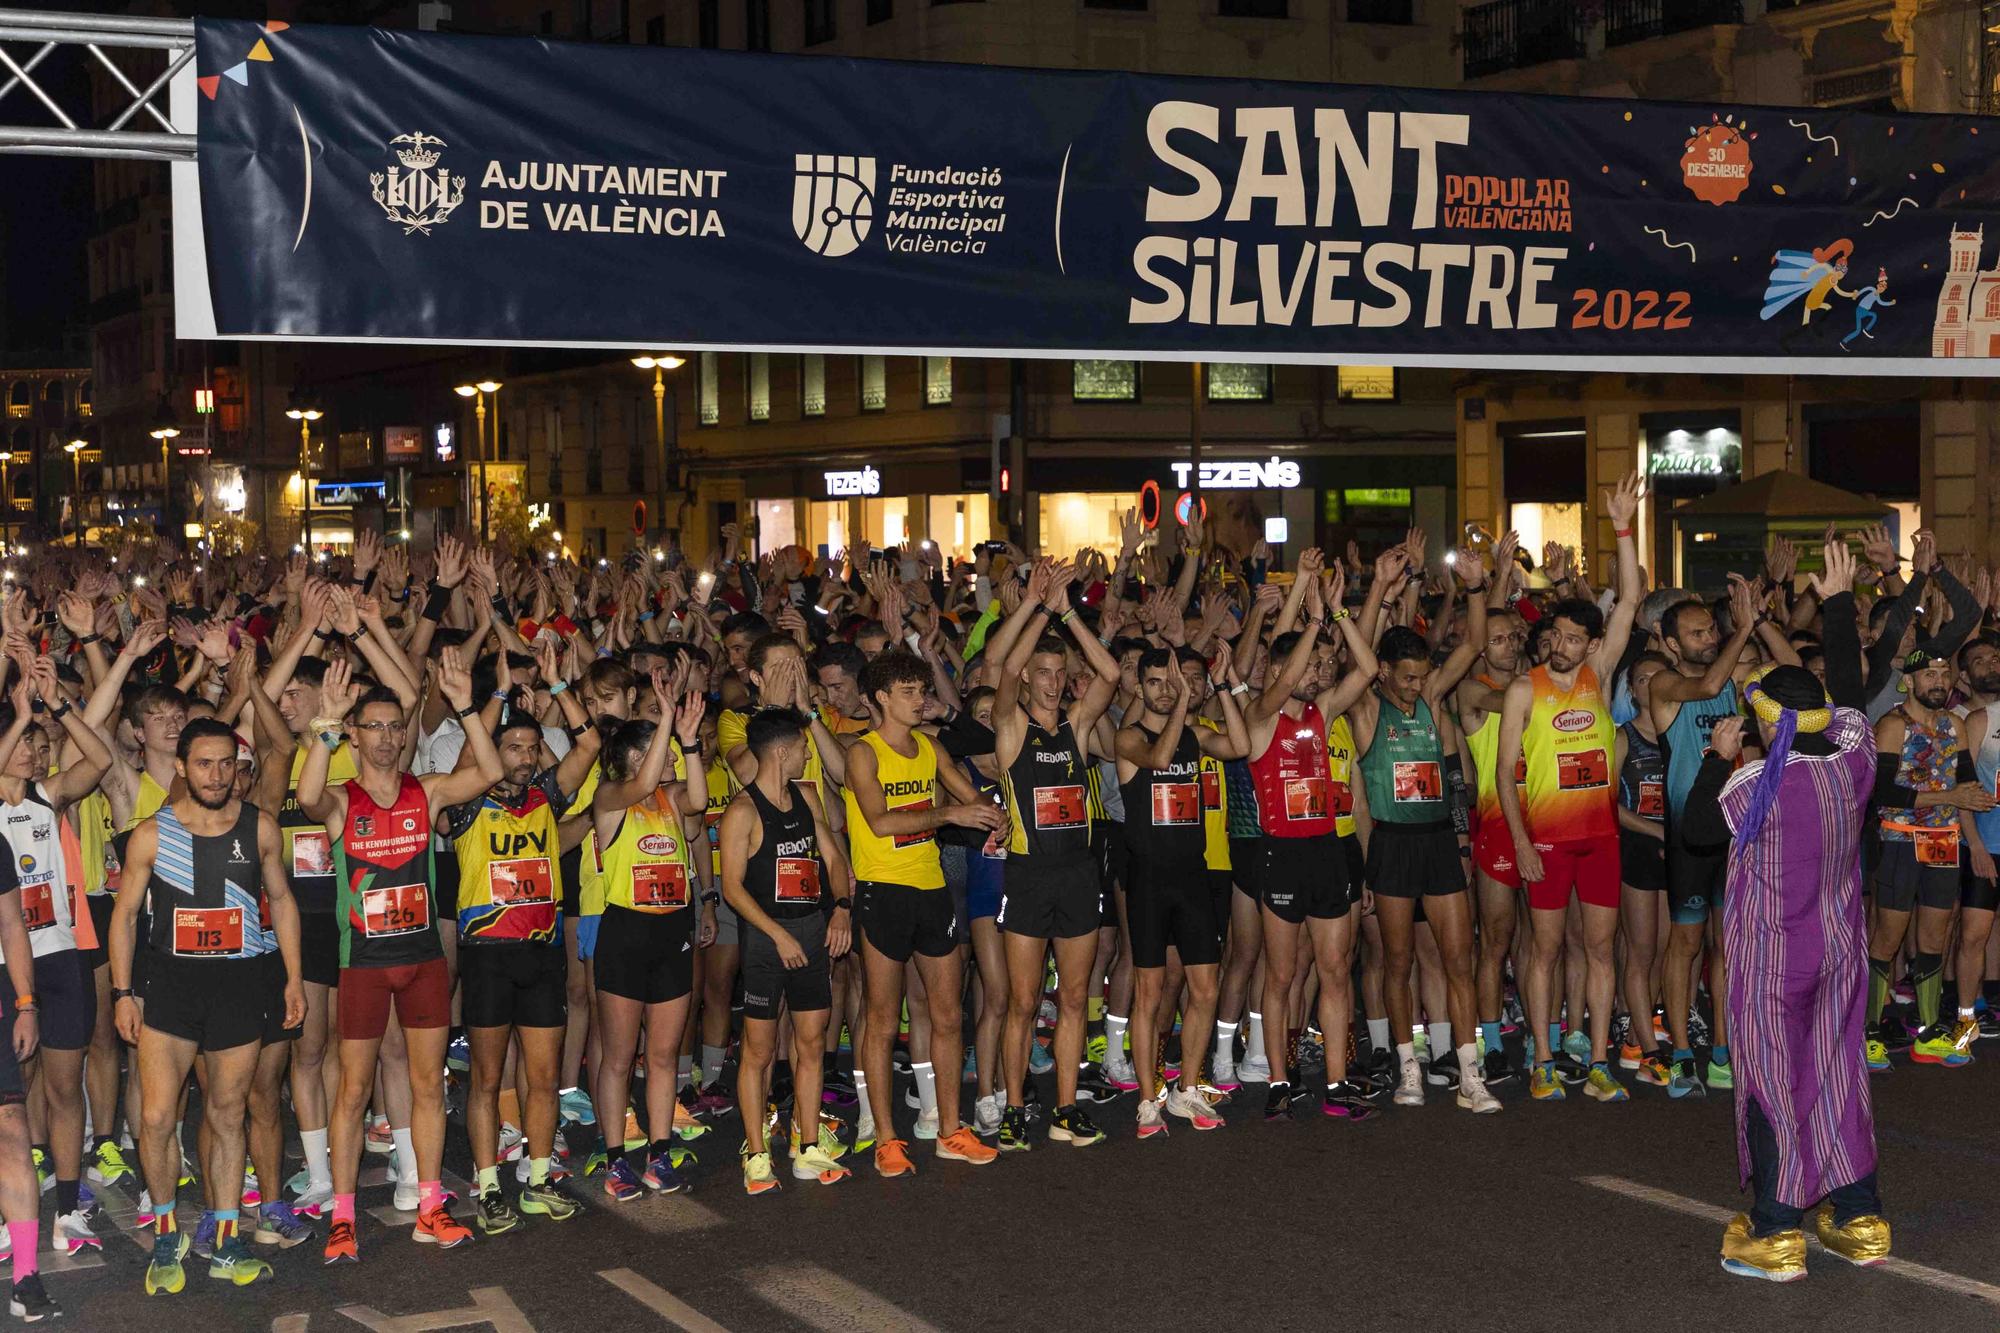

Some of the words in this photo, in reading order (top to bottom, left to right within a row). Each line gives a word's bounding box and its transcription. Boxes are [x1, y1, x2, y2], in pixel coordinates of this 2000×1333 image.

[1708, 147, 1726, 162] 30
[1145, 100, 1470, 230] SANT
[1687, 162, 1746, 178] DESEMBRE
[480, 160, 728, 198] AJUNTAMENT
[890, 164, 1002, 187] Fundació
[888, 187, 1005, 212] Esportiva
[1445, 175, 1571, 208] POPULAR
[480, 200, 529, 230] DE
[543, 198, 726, 238] VALÈNCIA
[886, 210, 1006, 236] Municipal
[885, 232, 987, 254] València
[1572, 289, 1692, 330] 2022
[1558, 714, 1592, 728] Serrano
[1576, 768, 1592, 781] 12
[1417, 780, 1426, 793] 4
[1060, 805, 1069, 819] 5
[1176, 802, 1184, 816] 7
[351, 842, 365, 850] THE
[391, 835, 415, 847] URBAN
[490, 828, 547, 856] UPV
[643, 839, 675, 850] Serrano
[649, 882, 675, 898] 213
[800, 878, 809, 893] 8
[384, 907, 415, 926] 126
[197, 930, 222, 947] 113
